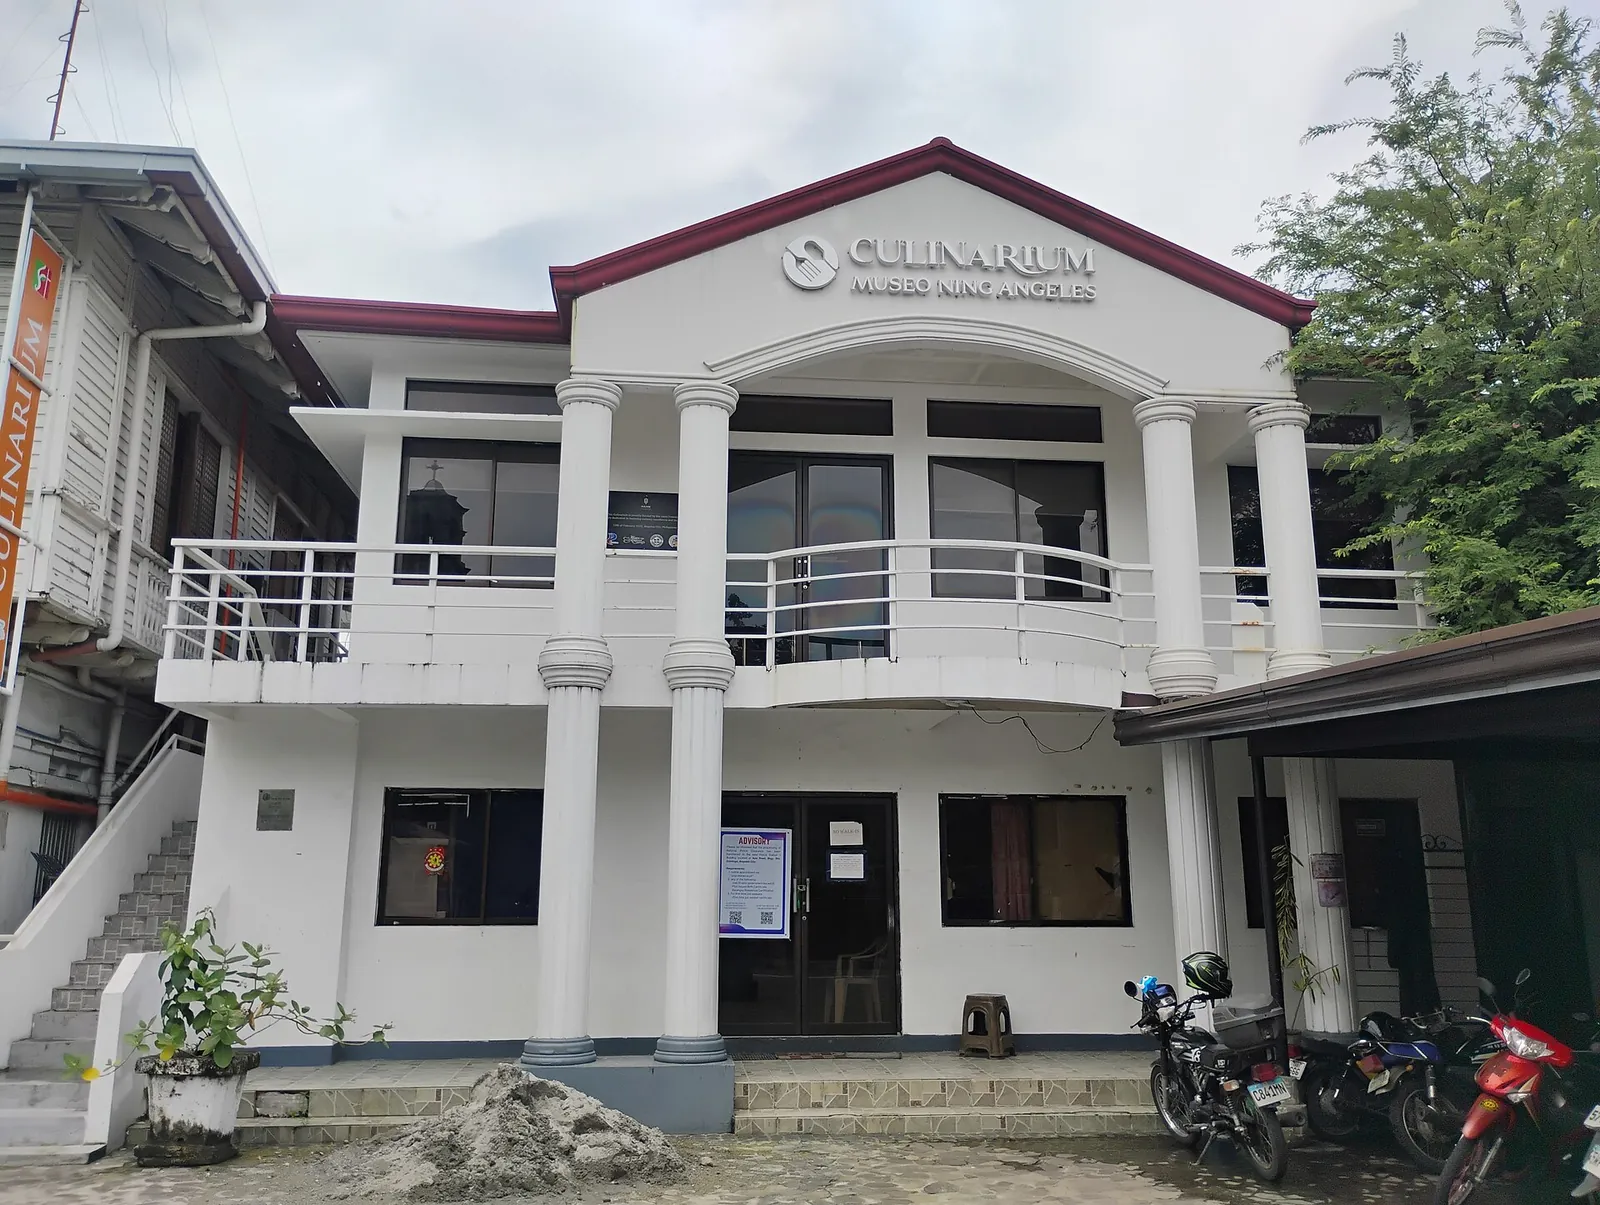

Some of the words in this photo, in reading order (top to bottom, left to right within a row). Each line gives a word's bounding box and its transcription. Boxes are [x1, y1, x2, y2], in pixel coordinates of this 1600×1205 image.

[849, 237, 1096, 277] CULINARIUM
[851, 275, 931, 295] MUSEO
[938, 279, 993, 298] NING
[996, 280, 1097, 301] ANGELES
[738, 837, 770, 845] ADVISORY
[1253, 1083, 1287, 1101] C841MN
